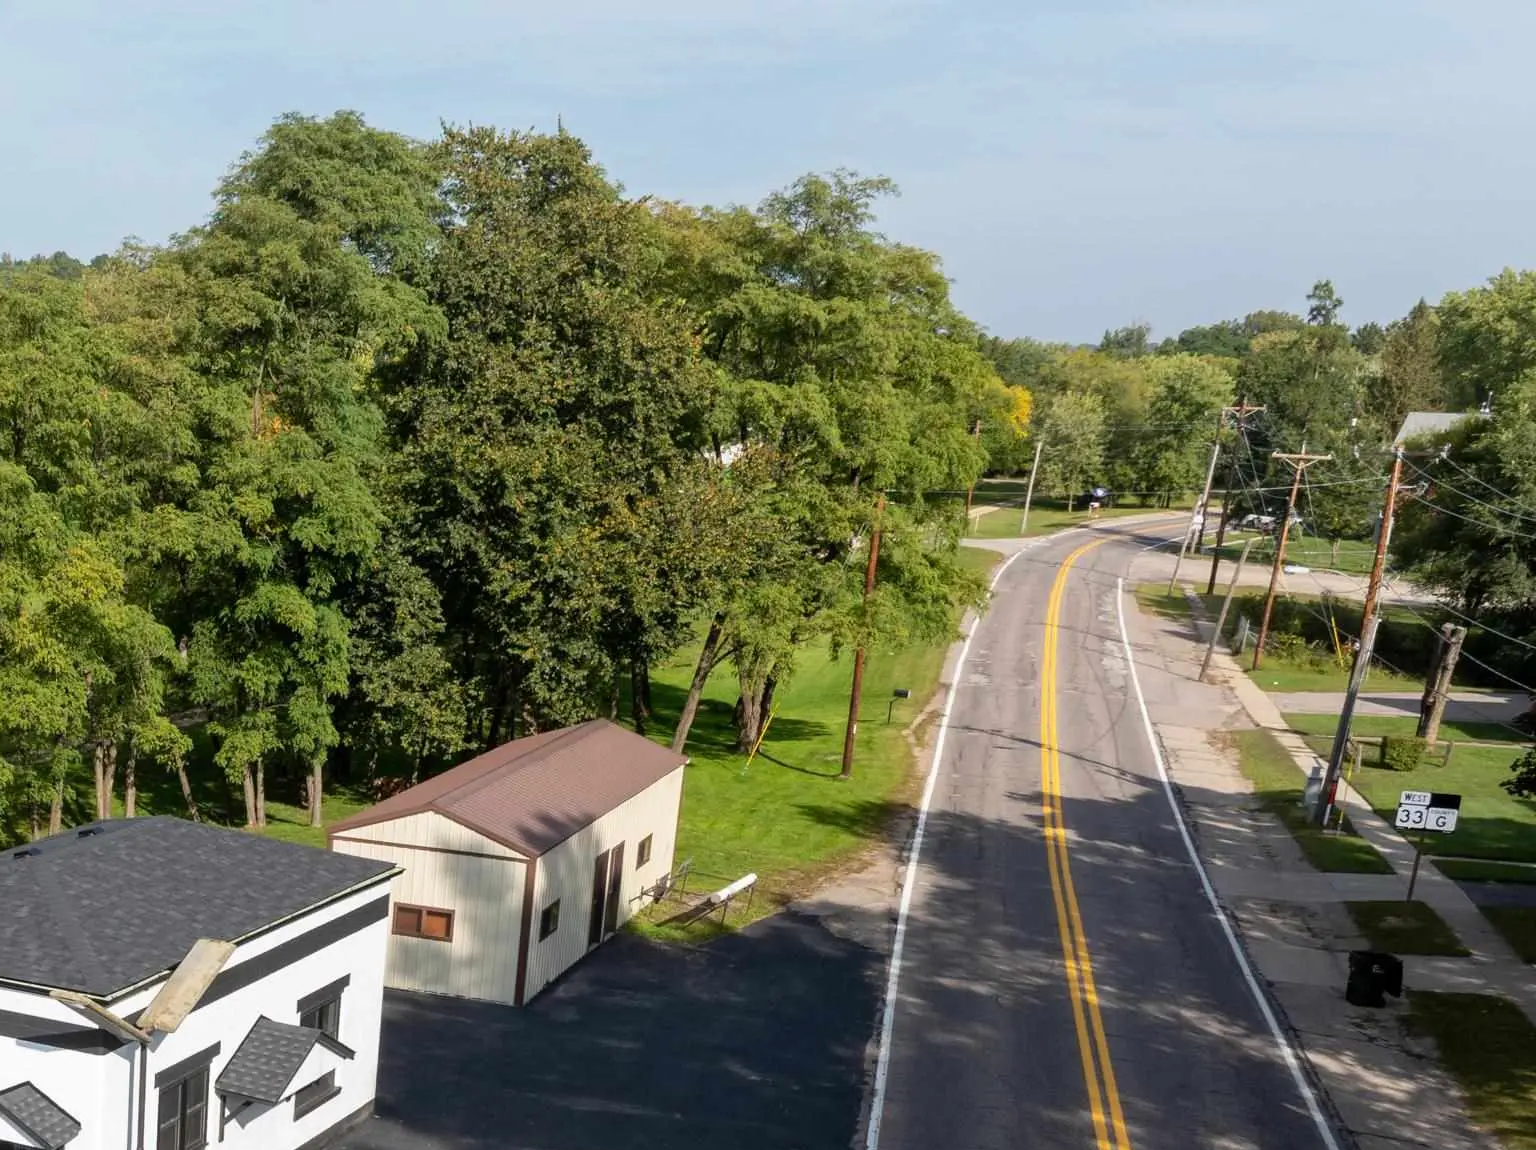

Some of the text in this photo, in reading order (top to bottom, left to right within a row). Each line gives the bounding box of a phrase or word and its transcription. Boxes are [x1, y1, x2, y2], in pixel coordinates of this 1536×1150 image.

[1405, 793, 1428, 802] WEST
[1399, 809, 1423, 824] 33
[1436, 815, 1446, 827] G
